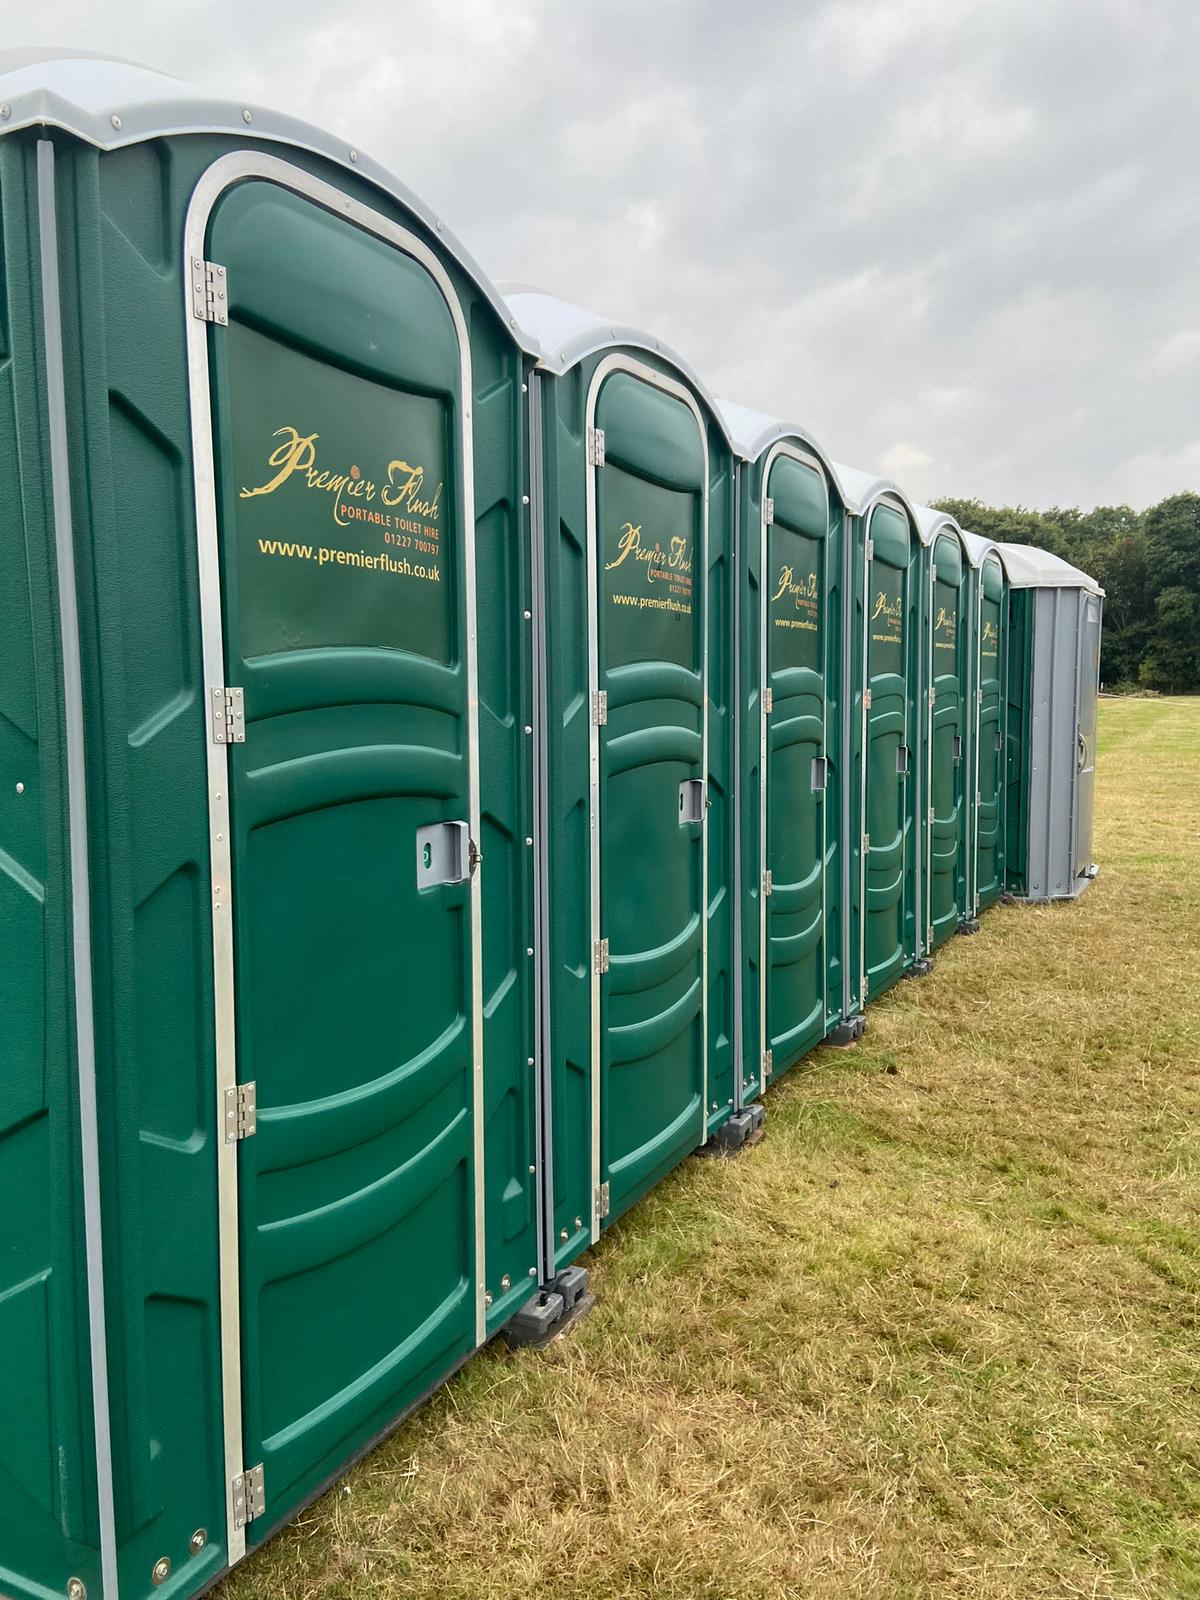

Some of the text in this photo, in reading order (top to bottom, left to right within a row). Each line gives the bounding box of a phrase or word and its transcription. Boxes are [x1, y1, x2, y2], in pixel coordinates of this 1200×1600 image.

[240, 426, 443, 526] Premier Flush
[340, 504, 439, 541] PORTABLE TOILET HIRE
[384, 532, 411, 549] 01227
[258, 539, 440, 581] www.premierflush.co.uk
